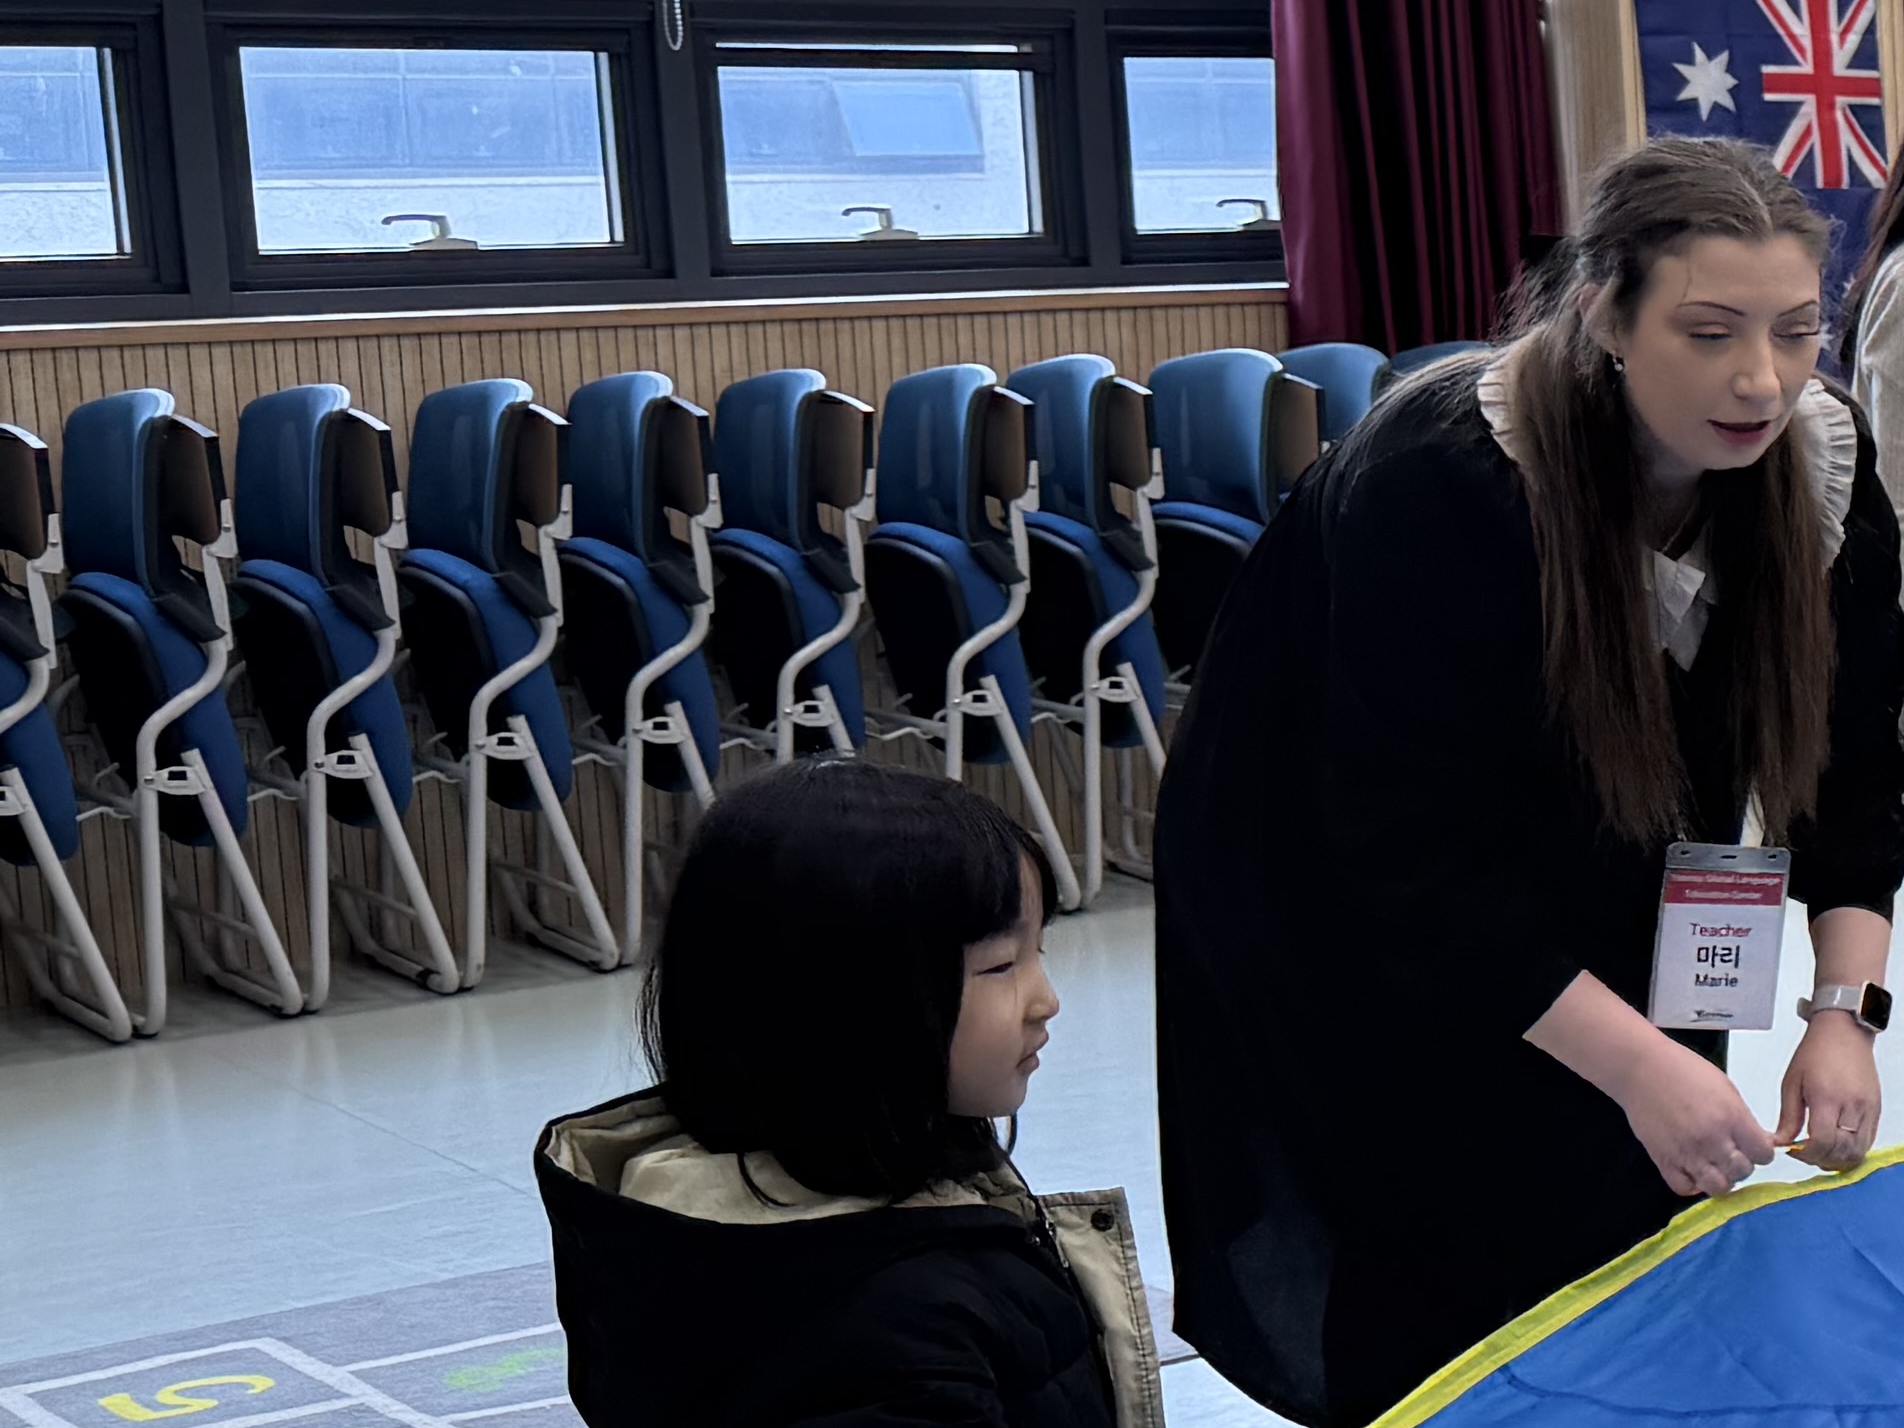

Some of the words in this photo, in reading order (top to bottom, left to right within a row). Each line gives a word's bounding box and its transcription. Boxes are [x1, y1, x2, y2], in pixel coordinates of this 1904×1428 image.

[1689, 922, 1752, 938] Teacher
[1697, 945, 1740, 969] 마리
[1695, 973, 1738, 988] Marie
[98, 1374, 276, 1421] 5
